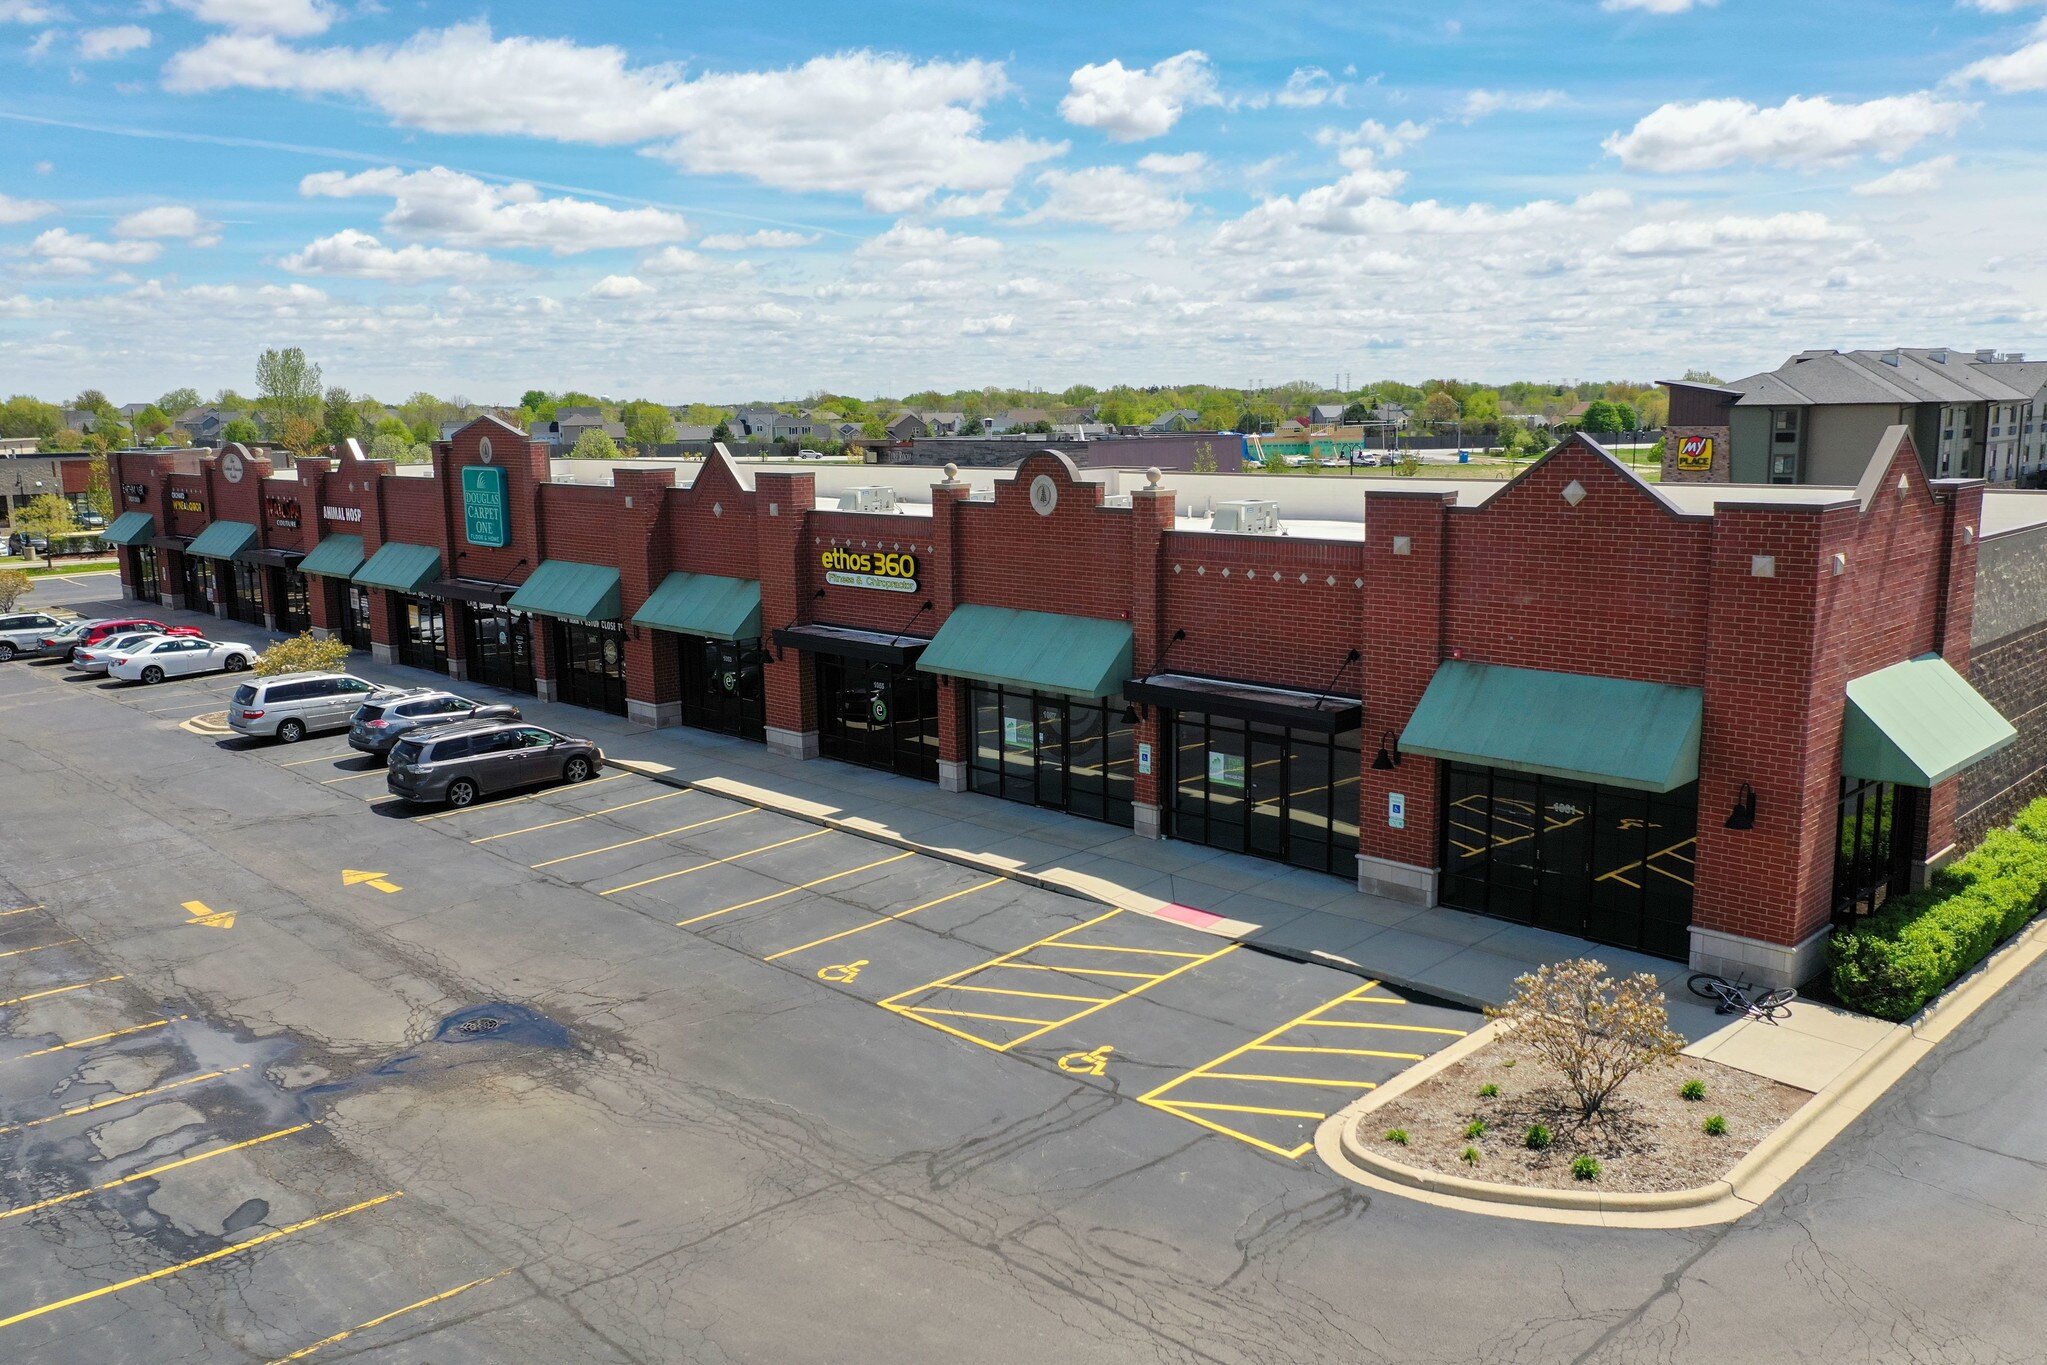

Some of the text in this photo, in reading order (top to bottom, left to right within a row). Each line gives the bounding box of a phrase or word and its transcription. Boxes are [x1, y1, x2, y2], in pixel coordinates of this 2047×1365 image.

[1680, 457, 1709, 465] PLACE
[466, 492, 499, 505] DOUGLAS
[323, 506, 362, 522] ANIMAL HOSP
[467, 505, 499, 521] CARPET
[276, 519, 297, 528] COUTURE
[475, 521, 494, 535] ONE
[470, 533, 484, 541] FLOOR
[488, 535, 500, 543] HOME
[822, 547, 915, 578] ethos 360
[828, 573, 855, 584] Fitness
[856, 576, 863, 585] &
